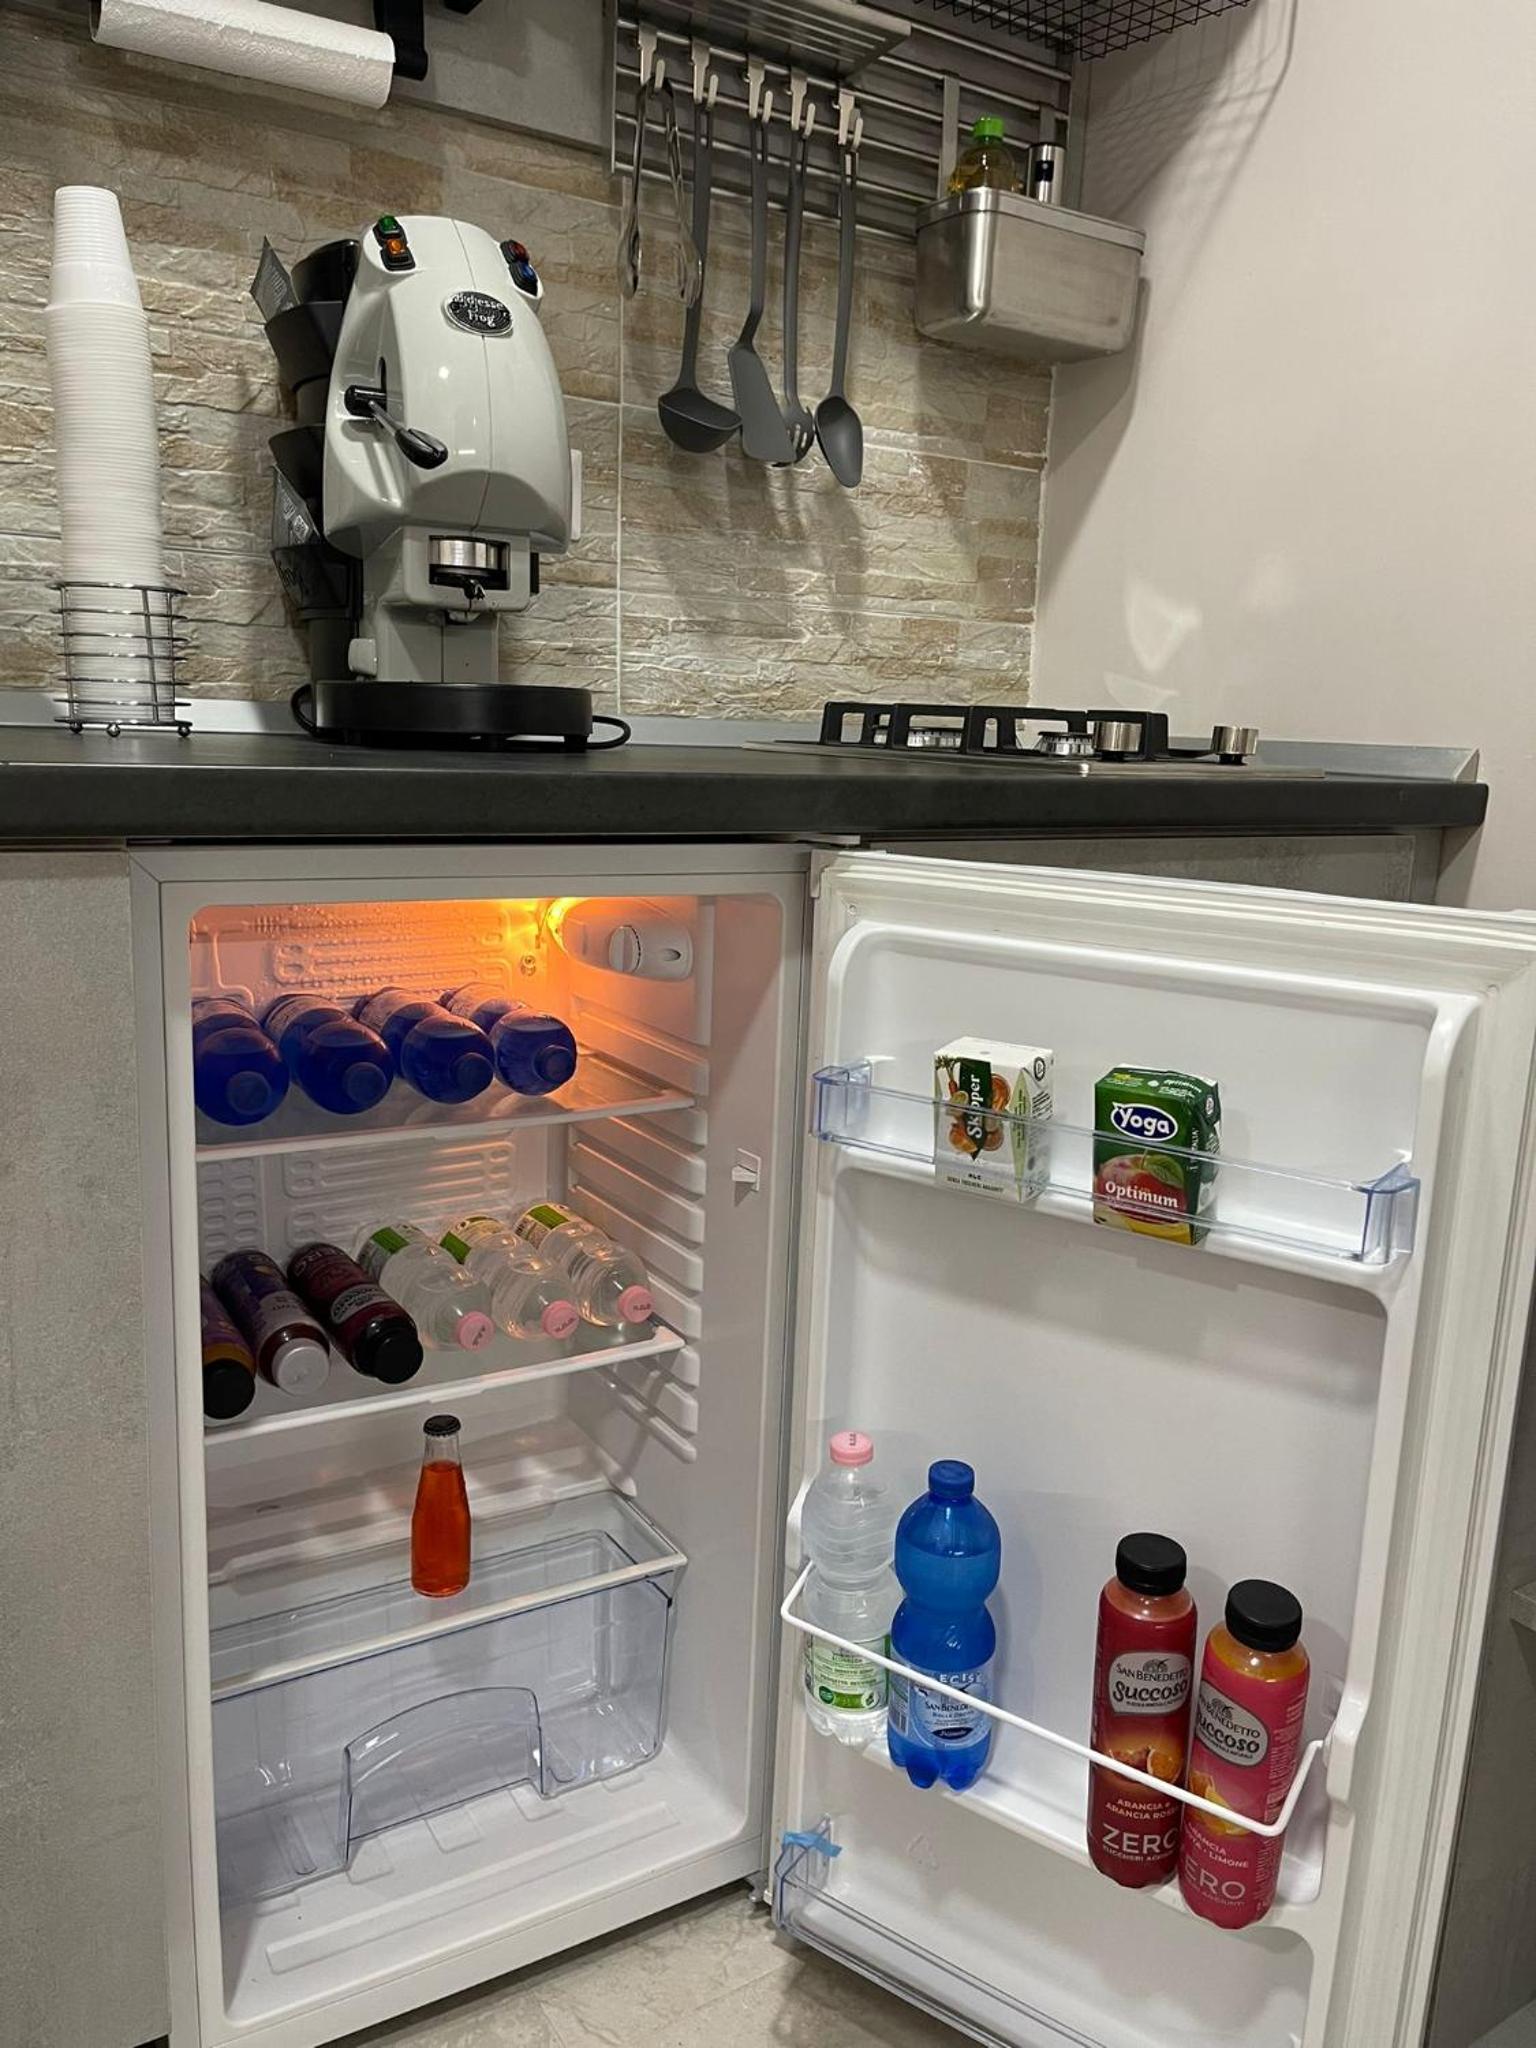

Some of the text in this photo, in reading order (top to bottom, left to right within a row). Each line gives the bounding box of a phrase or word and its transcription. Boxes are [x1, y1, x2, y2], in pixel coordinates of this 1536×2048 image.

[967, 1074, 984, 1139] Skpper
[1119, 1107, 1170, 1137] Yoga
[1104, 1180, 1179, 1208] Optimum
[1115, 1662, 1136, 1679] SAN
[1197, 1713, 1261, 1754] uccoso
[1117, 1798, 1163, 1812] ARANCIA
[1184, 1853, 1246, 1900] ERO
